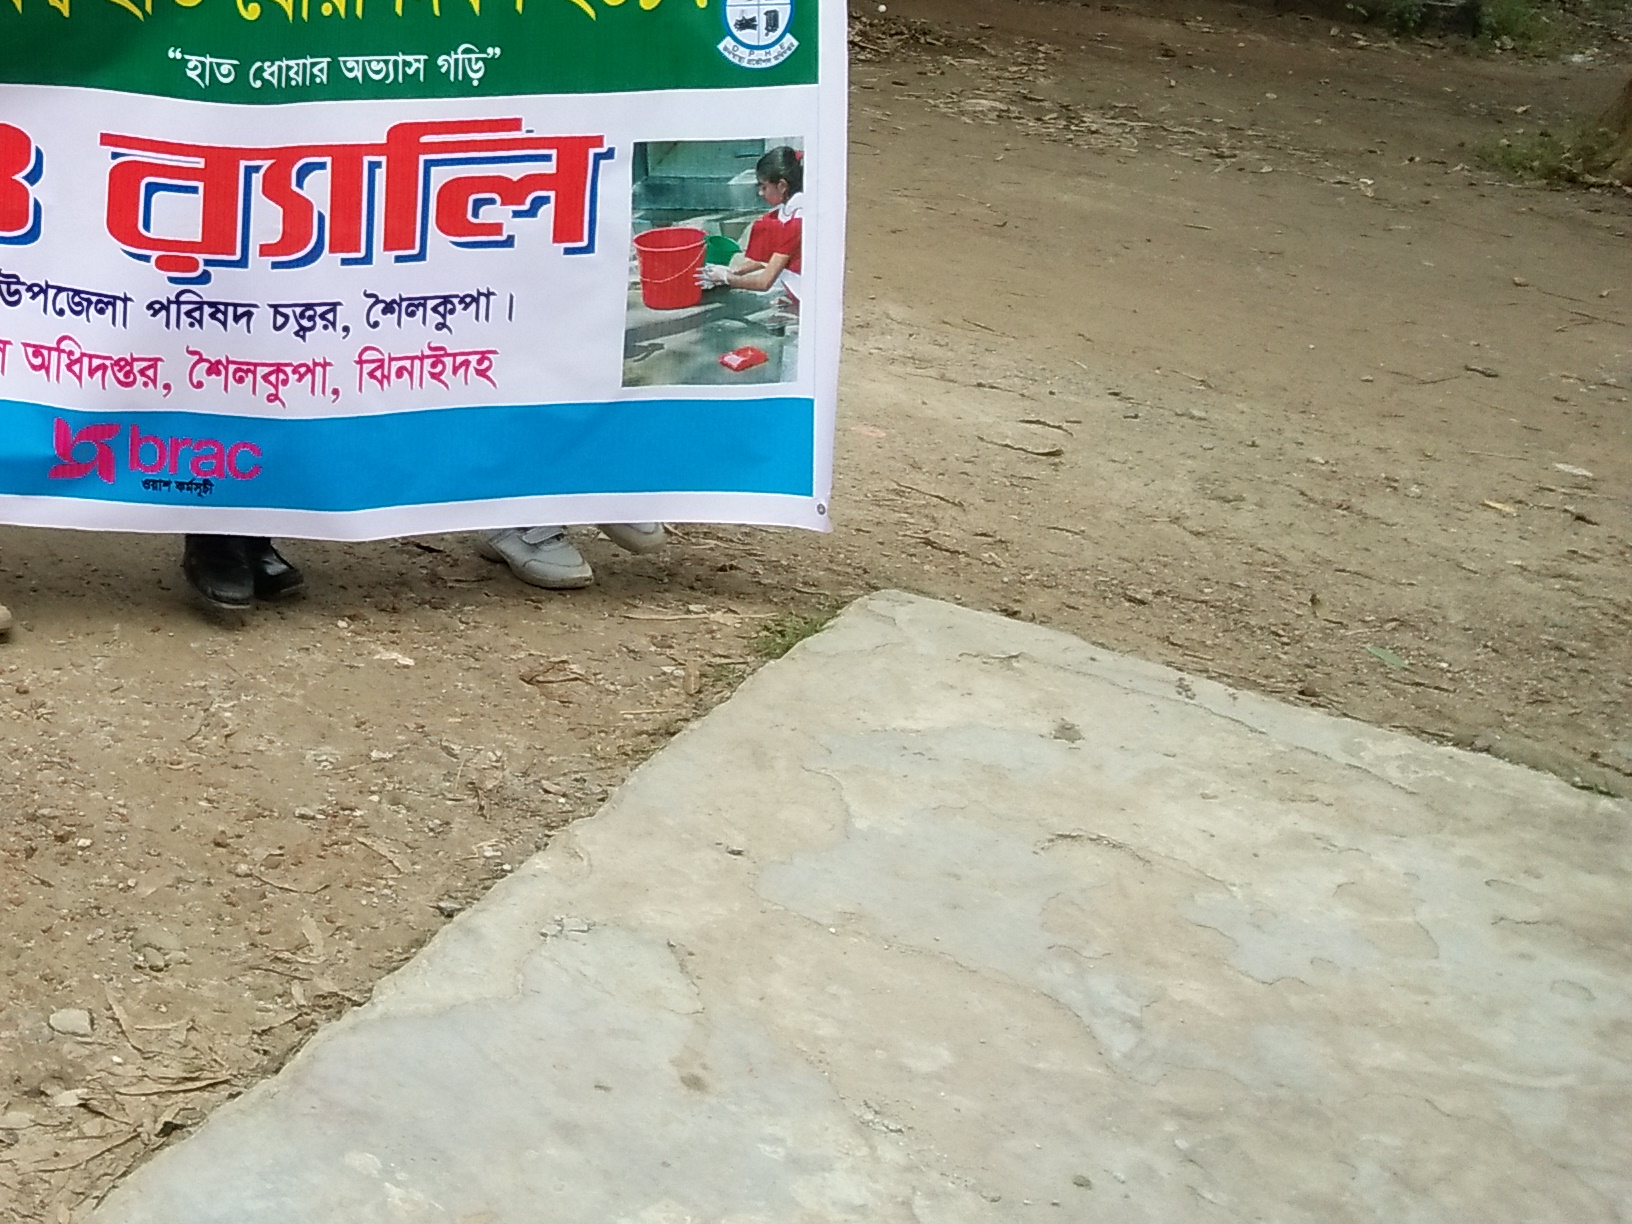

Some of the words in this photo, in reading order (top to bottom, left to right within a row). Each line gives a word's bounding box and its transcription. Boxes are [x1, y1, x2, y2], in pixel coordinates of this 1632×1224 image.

[167, 45, 240, 89] “হাত
[249, 54, 330, 90] ধোয়ার
[339, 53, 428, 86] অভ্যাস
[436, 43, 502, 88] গড়ি”
[99, 115, 616, 285] র‍্যালি
[145, 289, 256, 335] পরিষদ
[23, 334, 173, 398] অধিদপ্তর,
[185, 345, 340, 408] শৈলকুপা,
[355, 341, 500, 396] ঝিনাইদহ
[128, 423, 263, 480] brac
